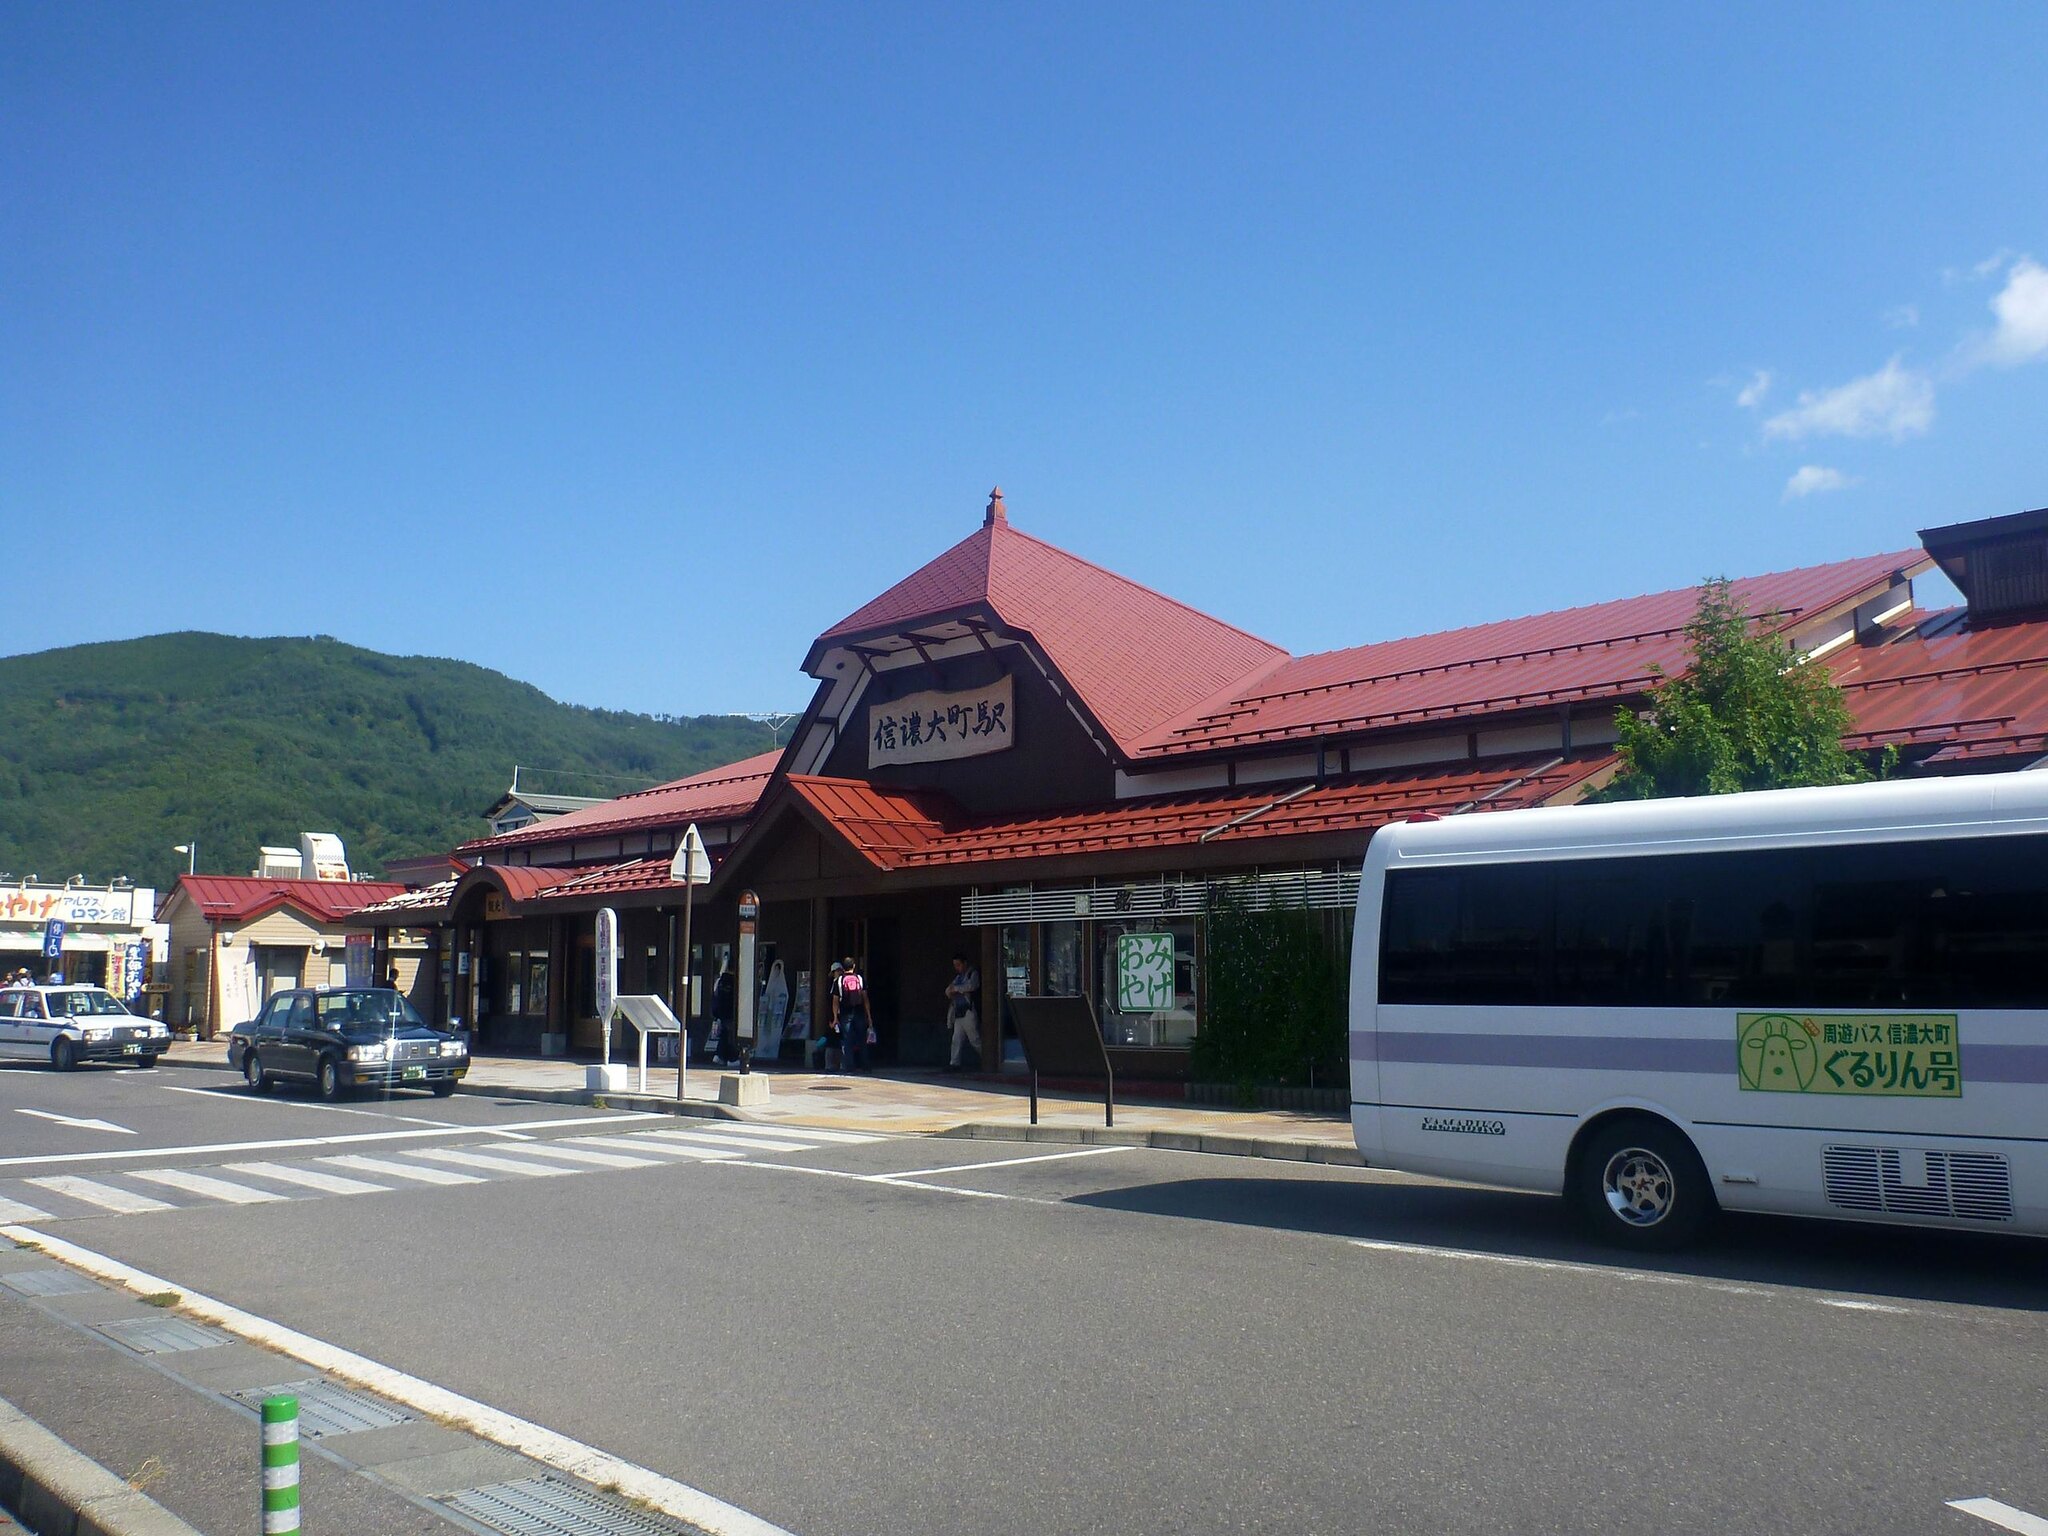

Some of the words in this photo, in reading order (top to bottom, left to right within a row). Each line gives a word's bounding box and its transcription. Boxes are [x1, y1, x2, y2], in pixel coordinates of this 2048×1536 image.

[874, 700, 1006, 750] 信濃大町駅
[0, 893, 61, 919] やげ
[63, 896, 101, 906] アルプス
[71, 908, 127, 921] ロマン館
[1120, 937, 1173, 971] おみ
[1120, 971, 1173, 1008] やげ
[1823, 1023, 1883, 1044] 周遊バス
[1887, 1023, 1950, 1045] 信濃大町
[1824, 1050, 1957, 1090] ぐるりん号
